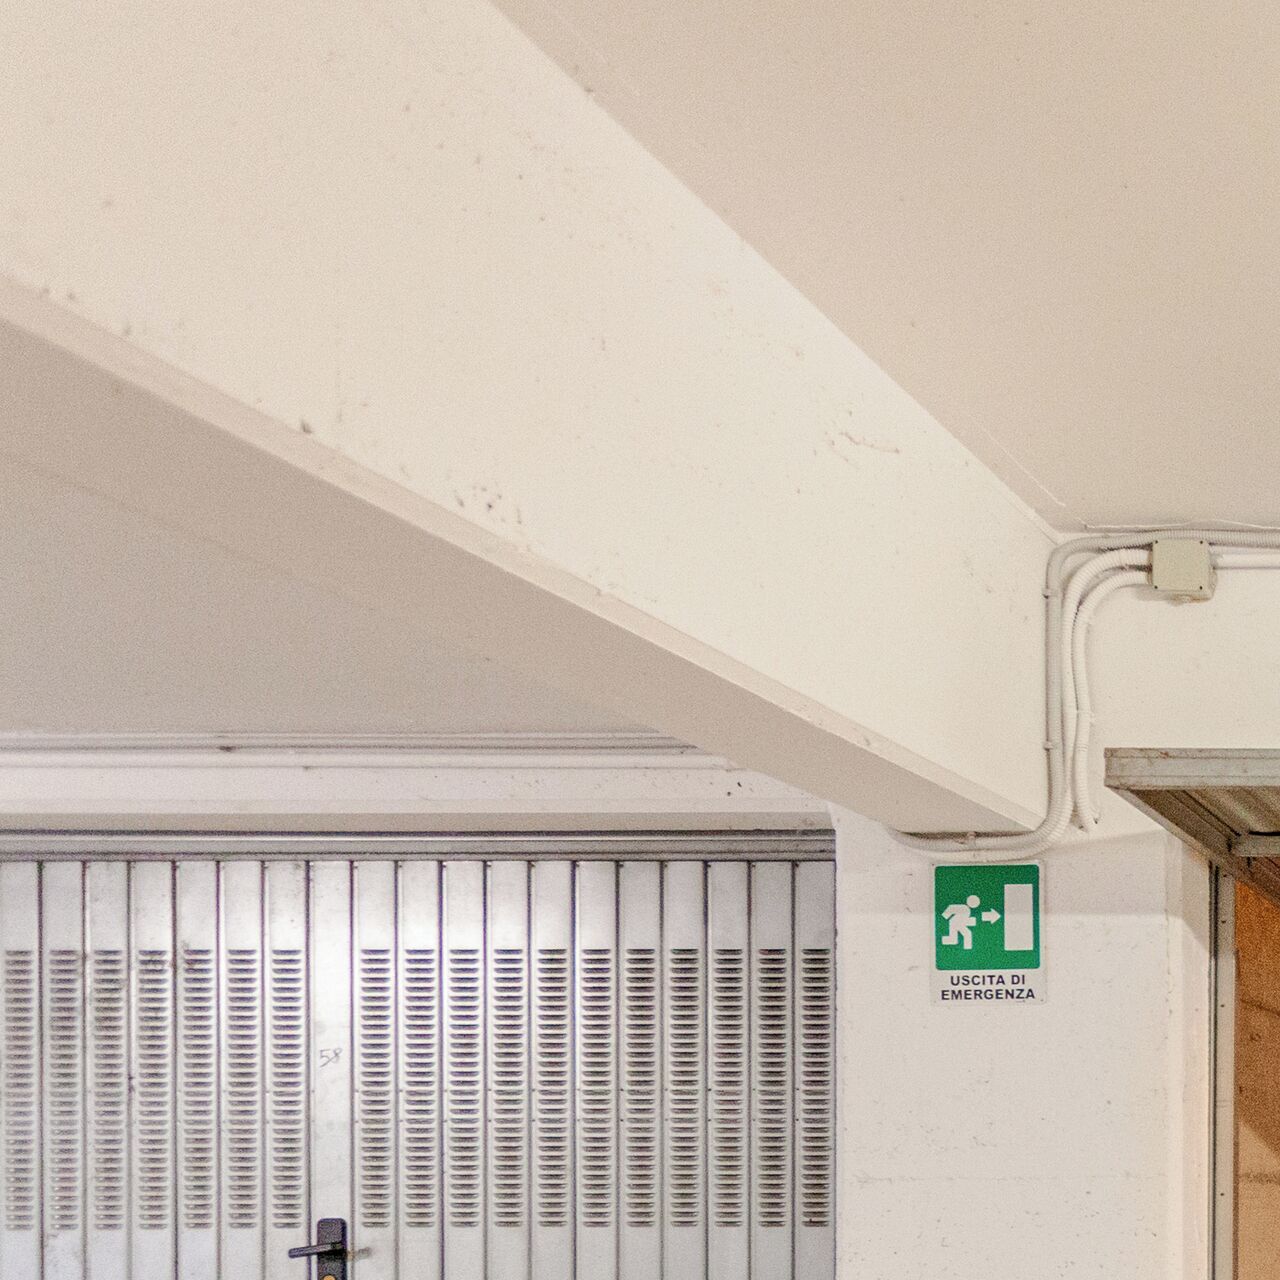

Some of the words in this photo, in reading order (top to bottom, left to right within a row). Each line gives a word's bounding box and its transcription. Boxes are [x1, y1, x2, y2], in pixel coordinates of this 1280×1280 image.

[950, 975, 1005, 986] USCITA
[1011, 974, 1025, 985] DI
[941, 988, 1035, 1000] EMERGENZA
[319, 1047, 343, 1068] 58
